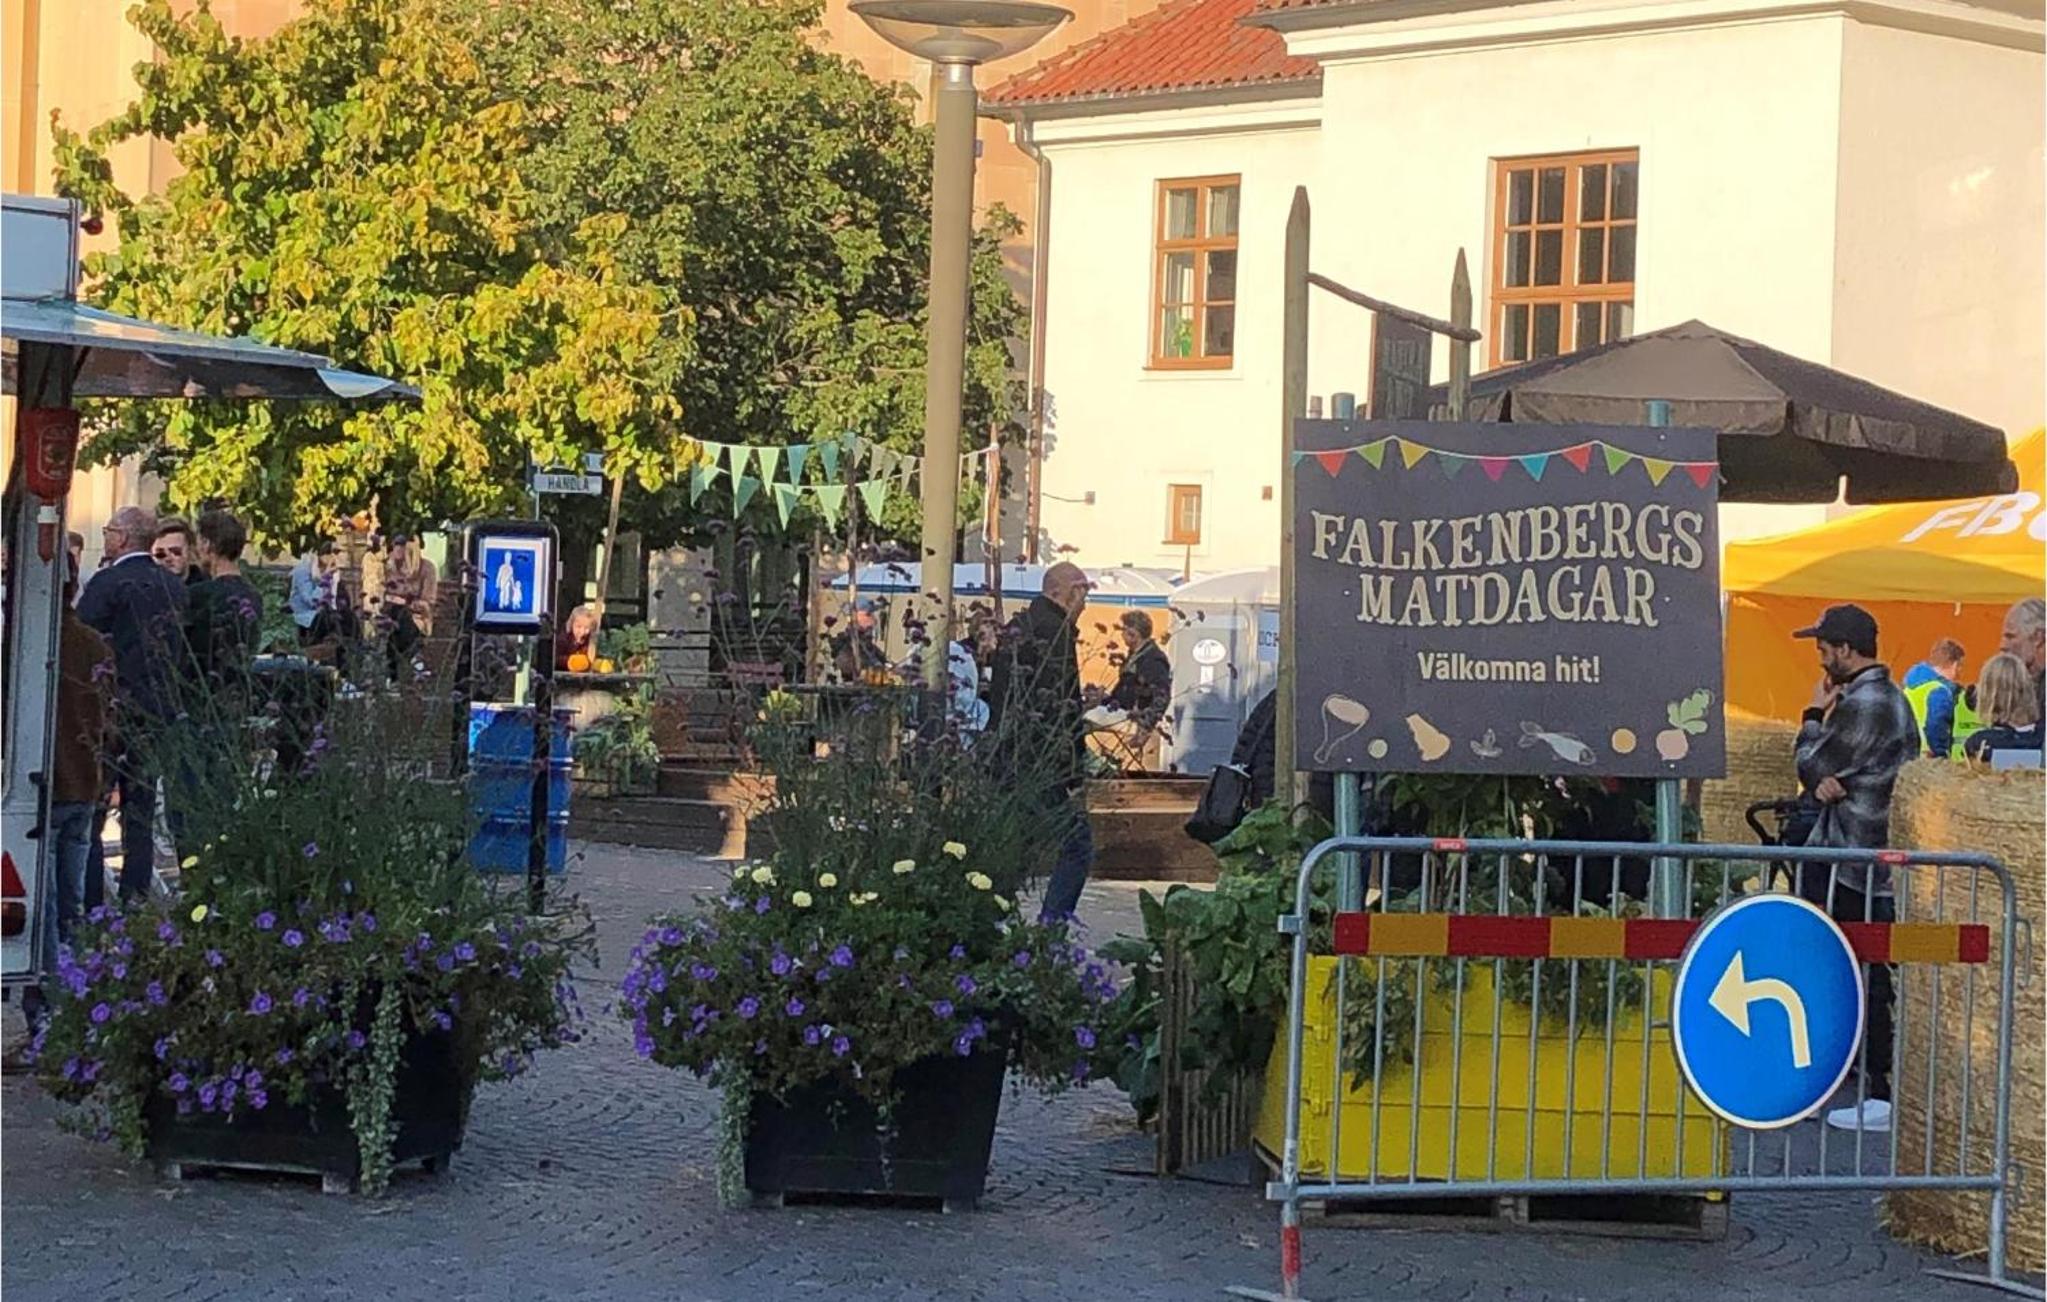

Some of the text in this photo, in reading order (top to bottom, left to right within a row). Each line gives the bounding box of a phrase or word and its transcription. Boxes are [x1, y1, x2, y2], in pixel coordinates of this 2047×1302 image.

[1310, 501, 1704, 570] FALKENBERGS
[1356, 565, 1659, 628] MATDAGAR
[1417, 651, 1601, 683] Välkomna hit!
